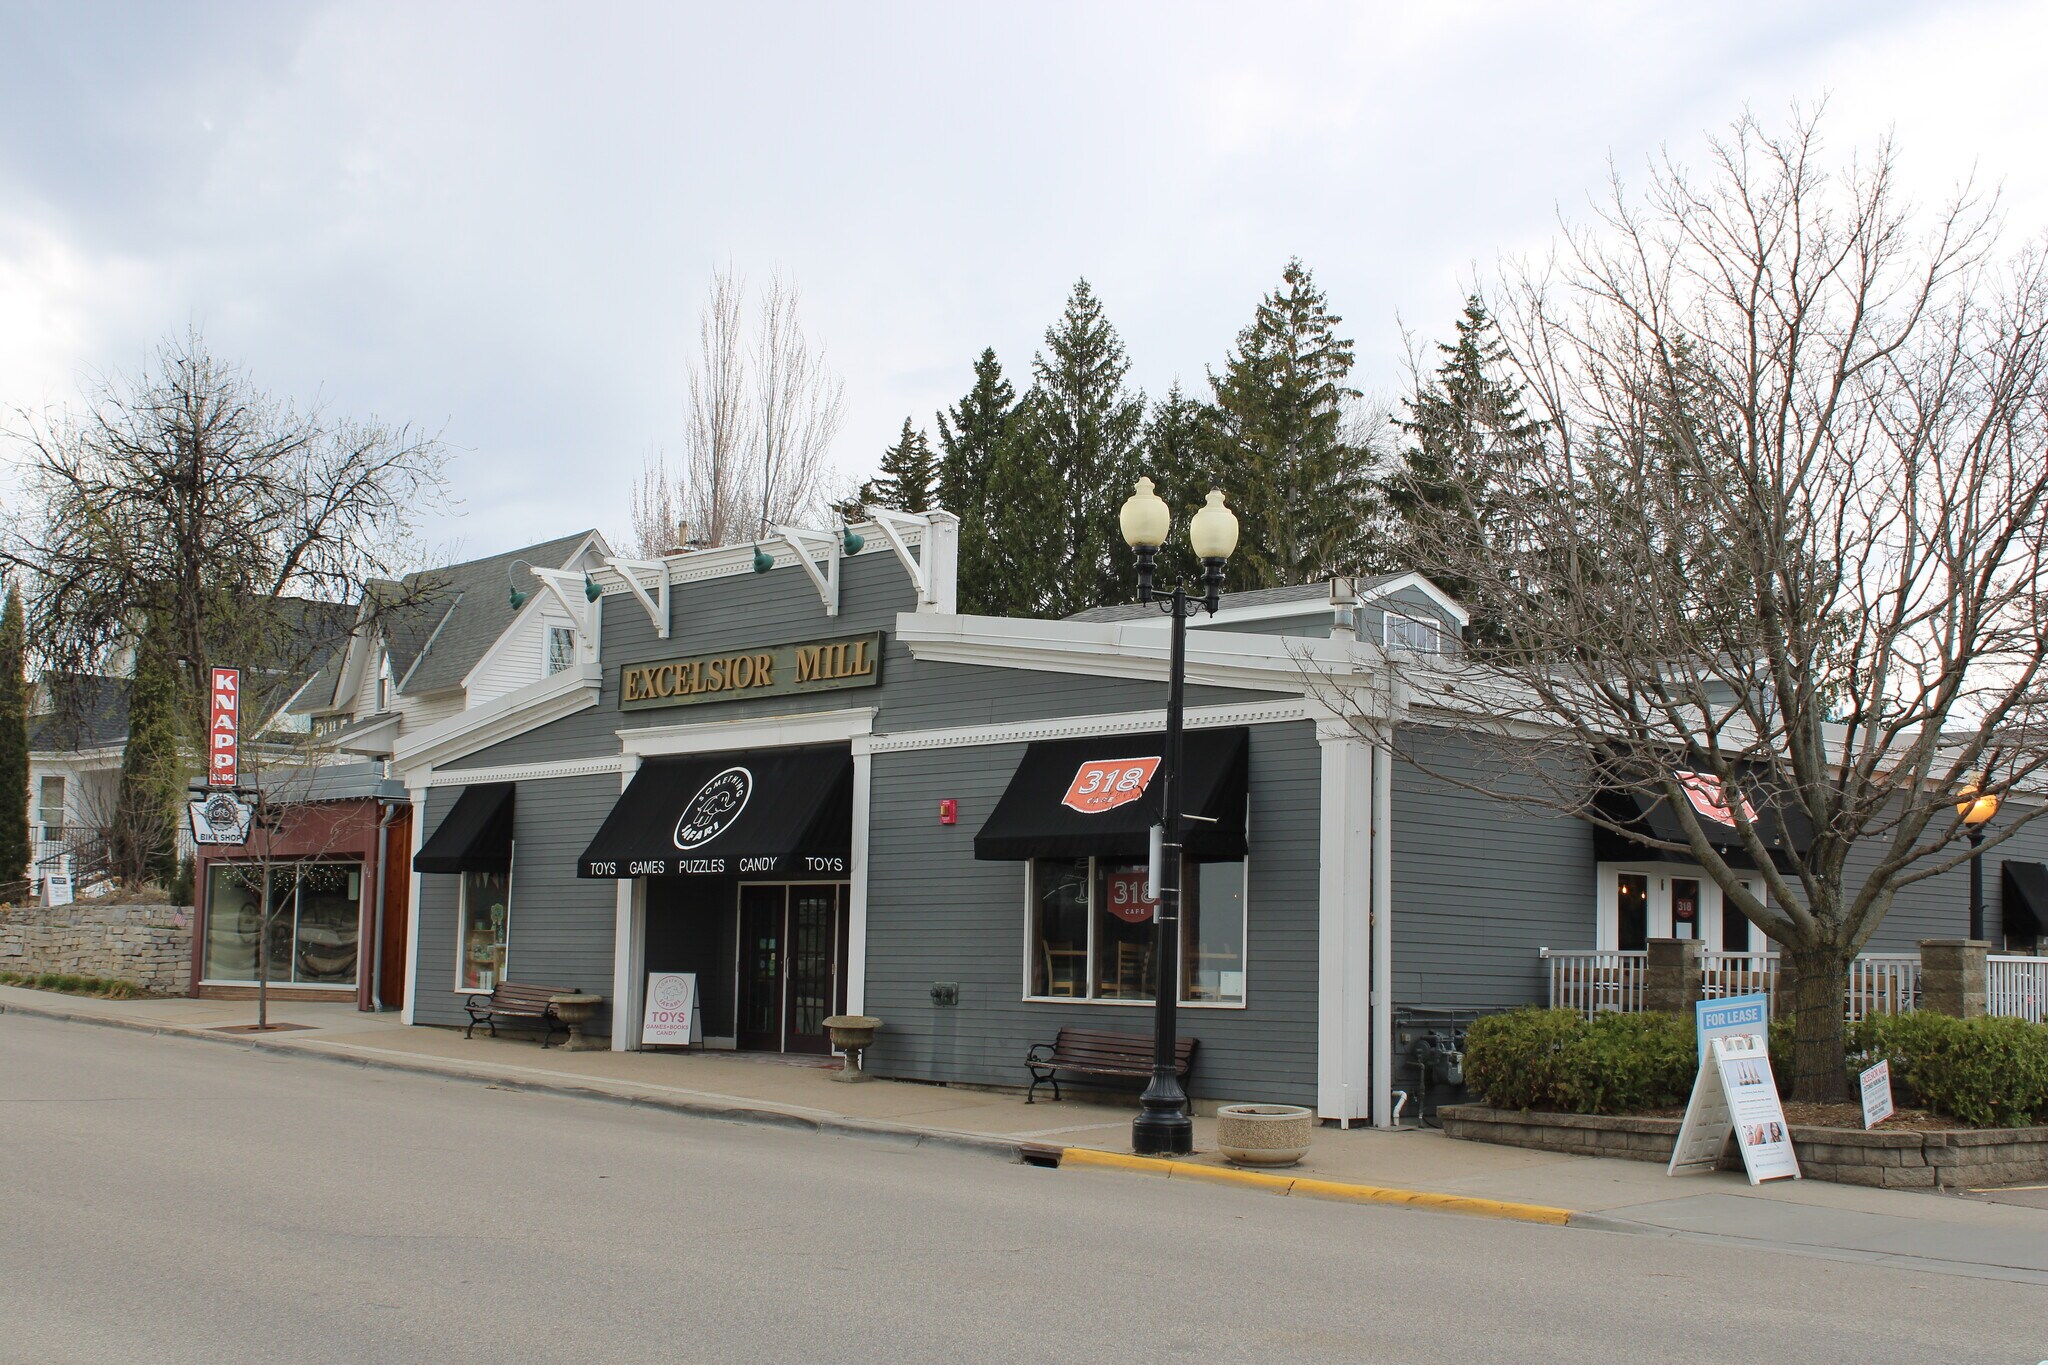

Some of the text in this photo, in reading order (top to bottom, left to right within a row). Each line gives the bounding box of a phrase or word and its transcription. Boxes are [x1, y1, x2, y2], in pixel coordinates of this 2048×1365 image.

[624, 641, 873, 701] EXCELSIOR MILL
[214, 674, 235, 769] KNAPP
[699, 775, 744, 801] SOMETHING
[1078, 767, 1144, 794] 318
[220, 834, 241, 842] SHOP
[682, 821, 719, 841] SAFARI
[590, 857, 843, 875] TOYS GAMES PUZZLES CANDY TOYS
[1114, 881, 1157, 904] 318
[1678, 901, 1692, 911] 318
[652, 1011, 685, 1023] TOYS
[1705, 1008, 1758, 1026] FOR LEASE
